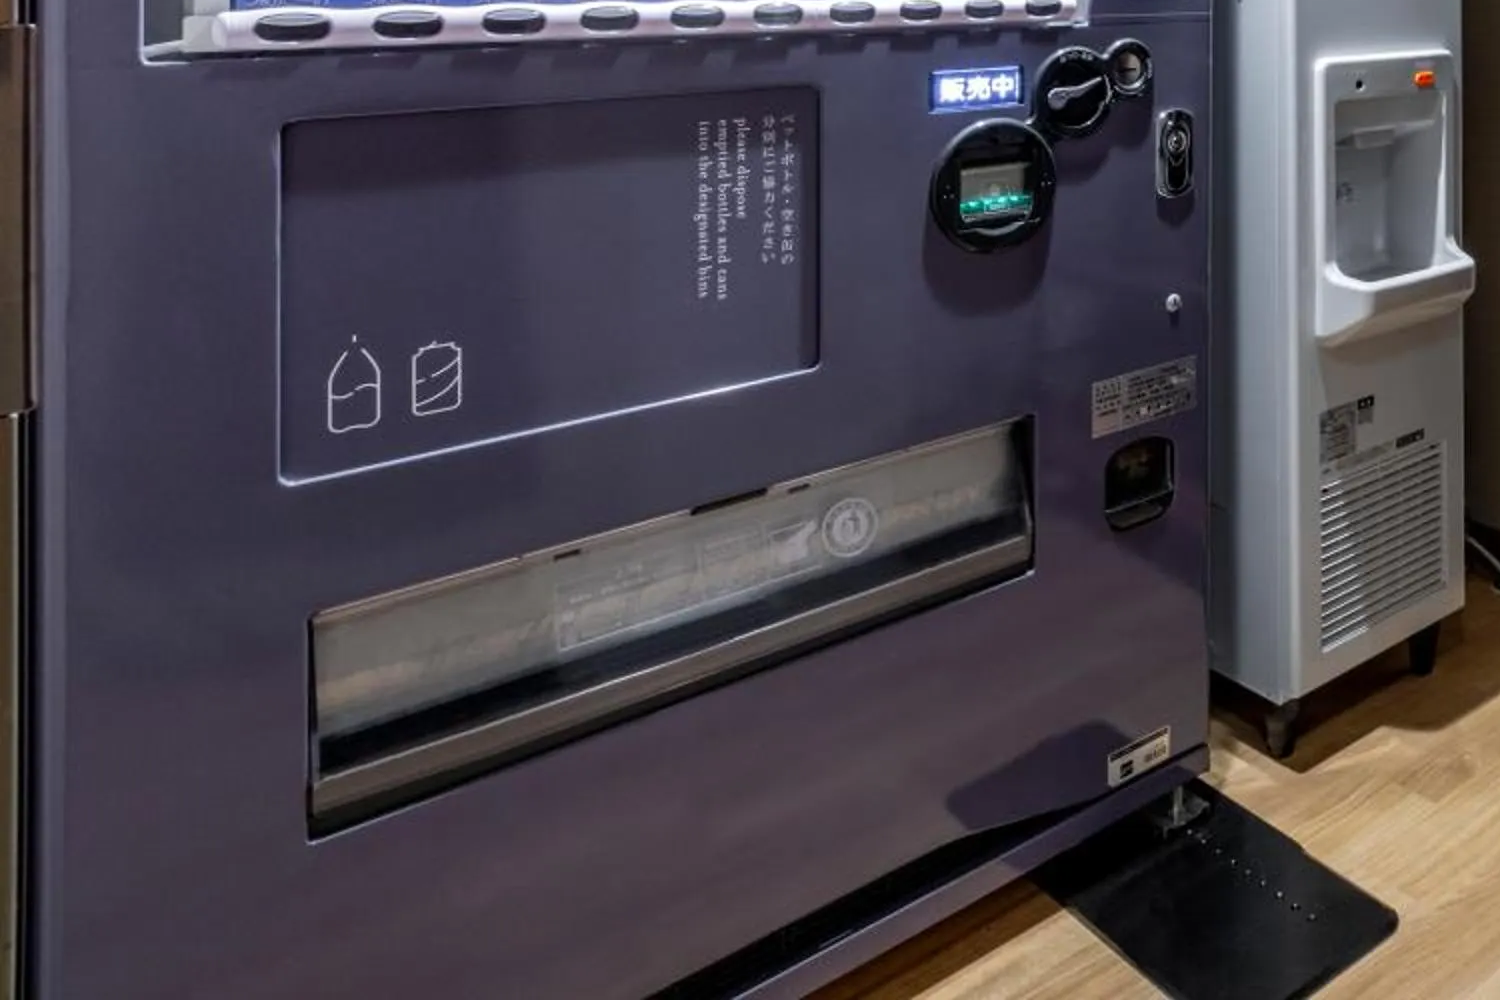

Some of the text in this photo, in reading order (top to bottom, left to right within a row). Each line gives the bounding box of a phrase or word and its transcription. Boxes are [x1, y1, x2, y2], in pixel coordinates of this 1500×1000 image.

[939, 73, 1015, 103] 販売中
[693, 120, 713, 299] into the designated bins
[714, 119, 732, 300] emptied bottles and cans
[733, 117, 751, 219] please dispose
